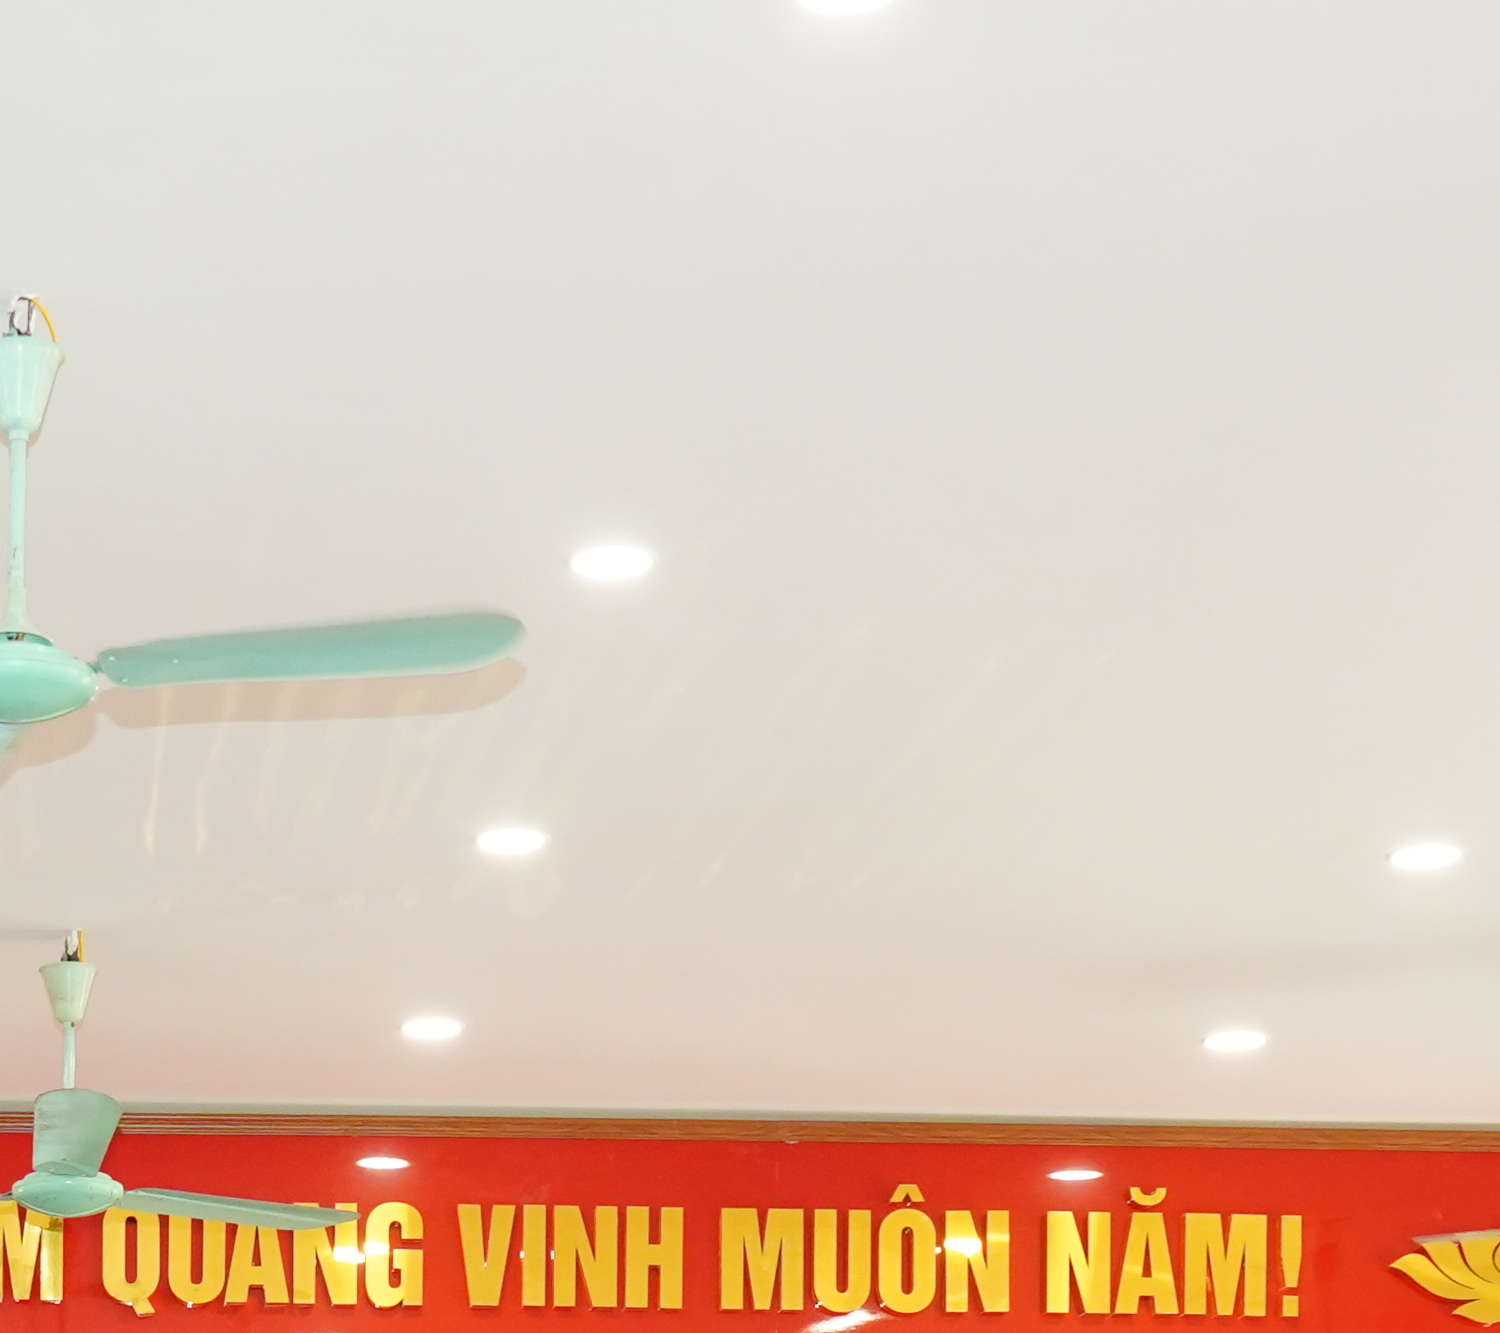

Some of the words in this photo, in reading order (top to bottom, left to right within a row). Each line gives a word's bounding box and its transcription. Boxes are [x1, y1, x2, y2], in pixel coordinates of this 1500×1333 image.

[102, 1202, 424, 1317] QUANG
[458, 1203, 684, 1310] VINH
[719, 1184, 1010, 1315] MUÔN
[1045, 1186, 1302, 1318] NĂM!
